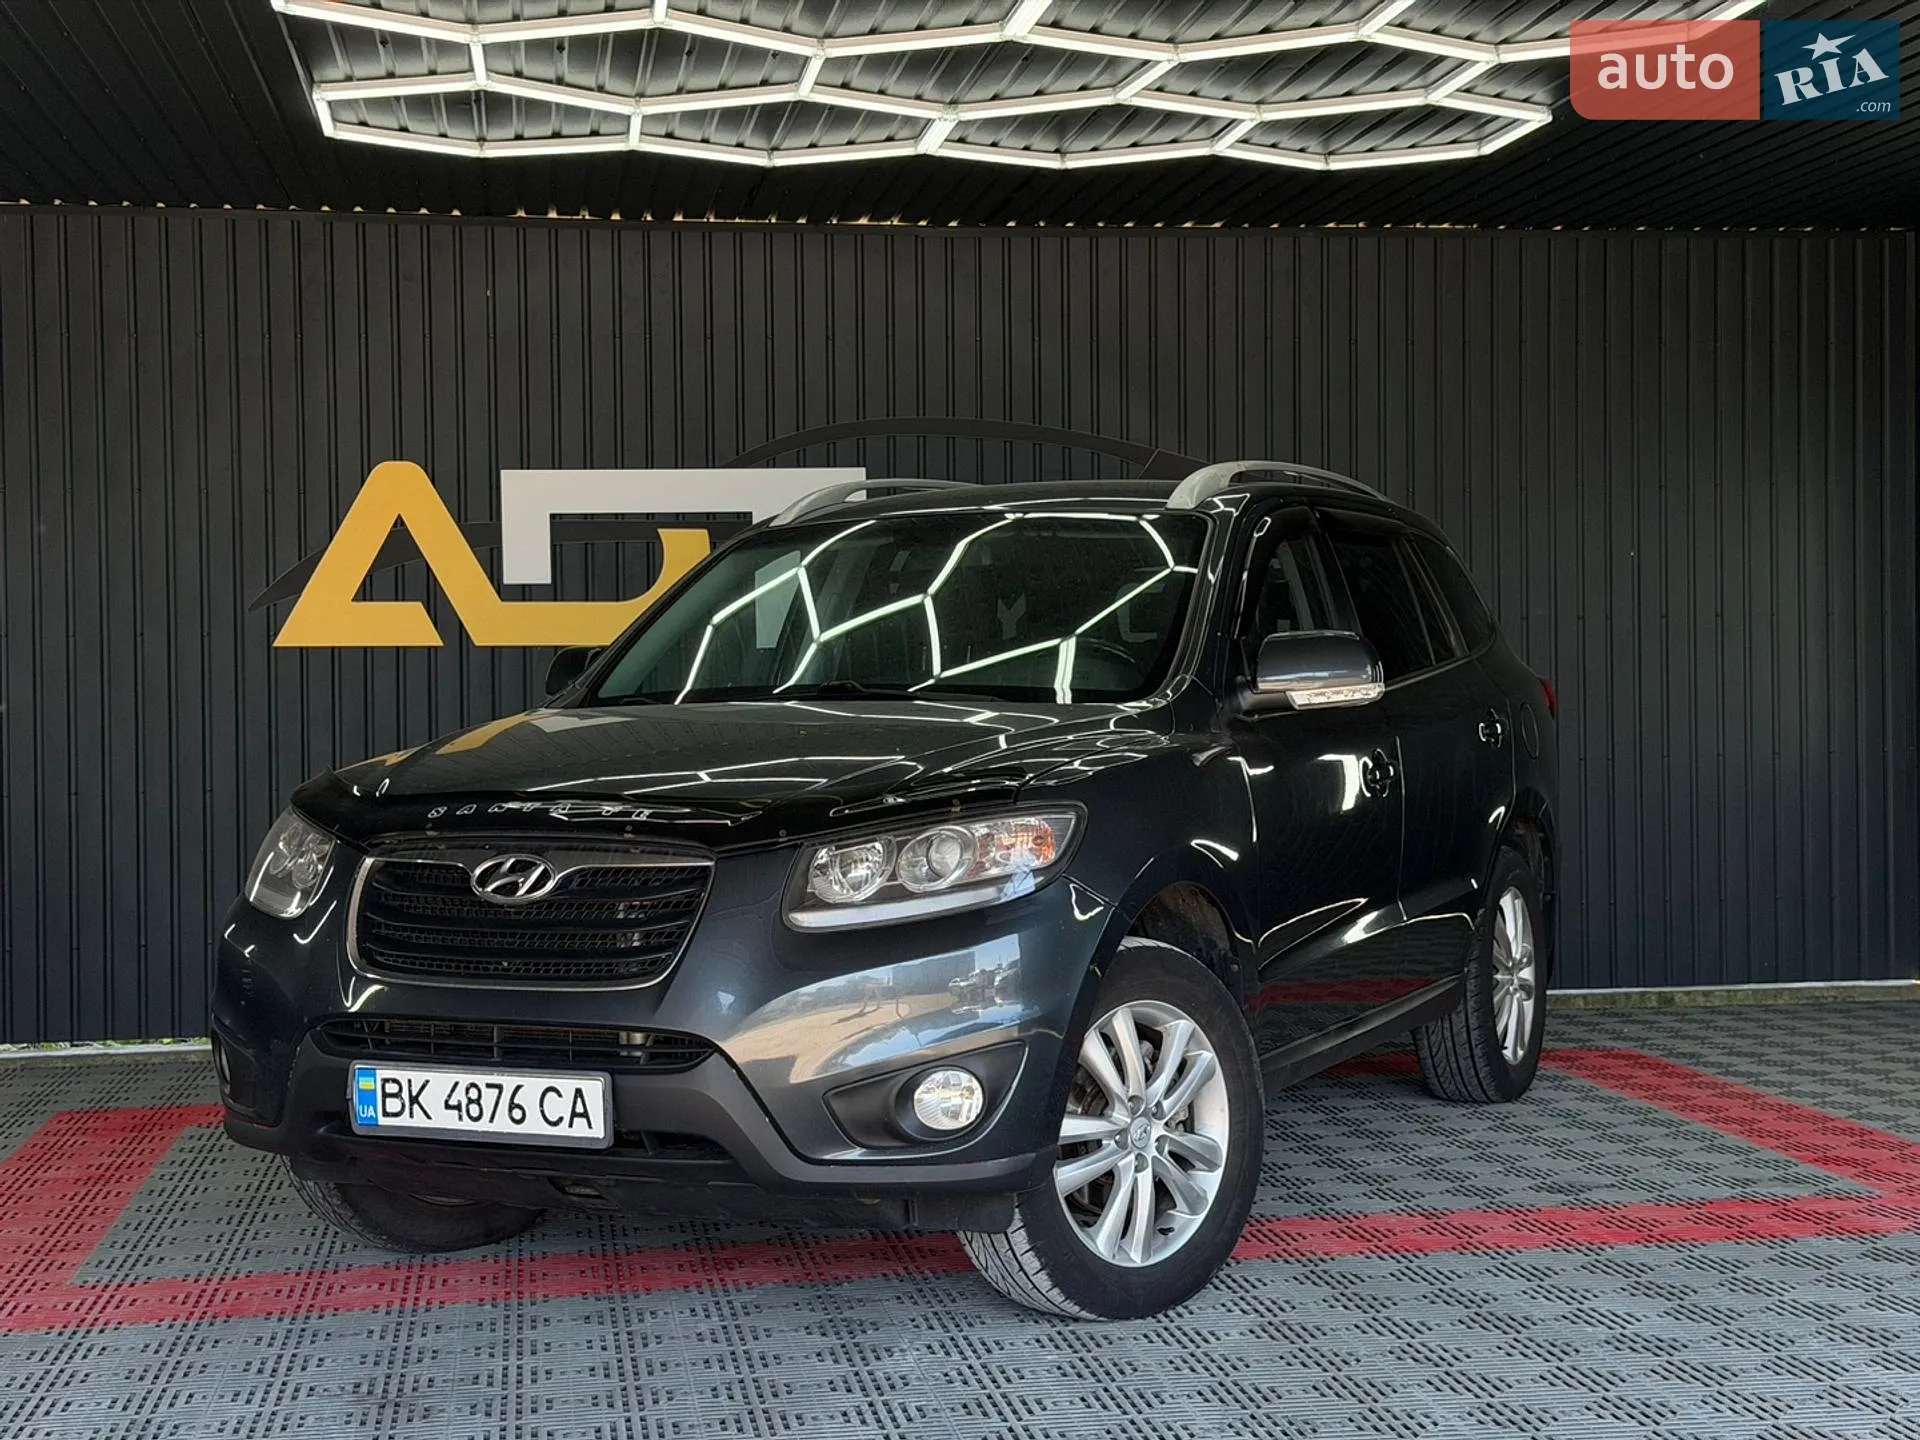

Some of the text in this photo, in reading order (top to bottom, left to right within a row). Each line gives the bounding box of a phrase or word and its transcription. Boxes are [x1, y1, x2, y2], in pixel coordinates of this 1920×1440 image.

[359, 1104, 376, 1119] UA
[380, 1077, 594, 1129] BK 4876 CA
